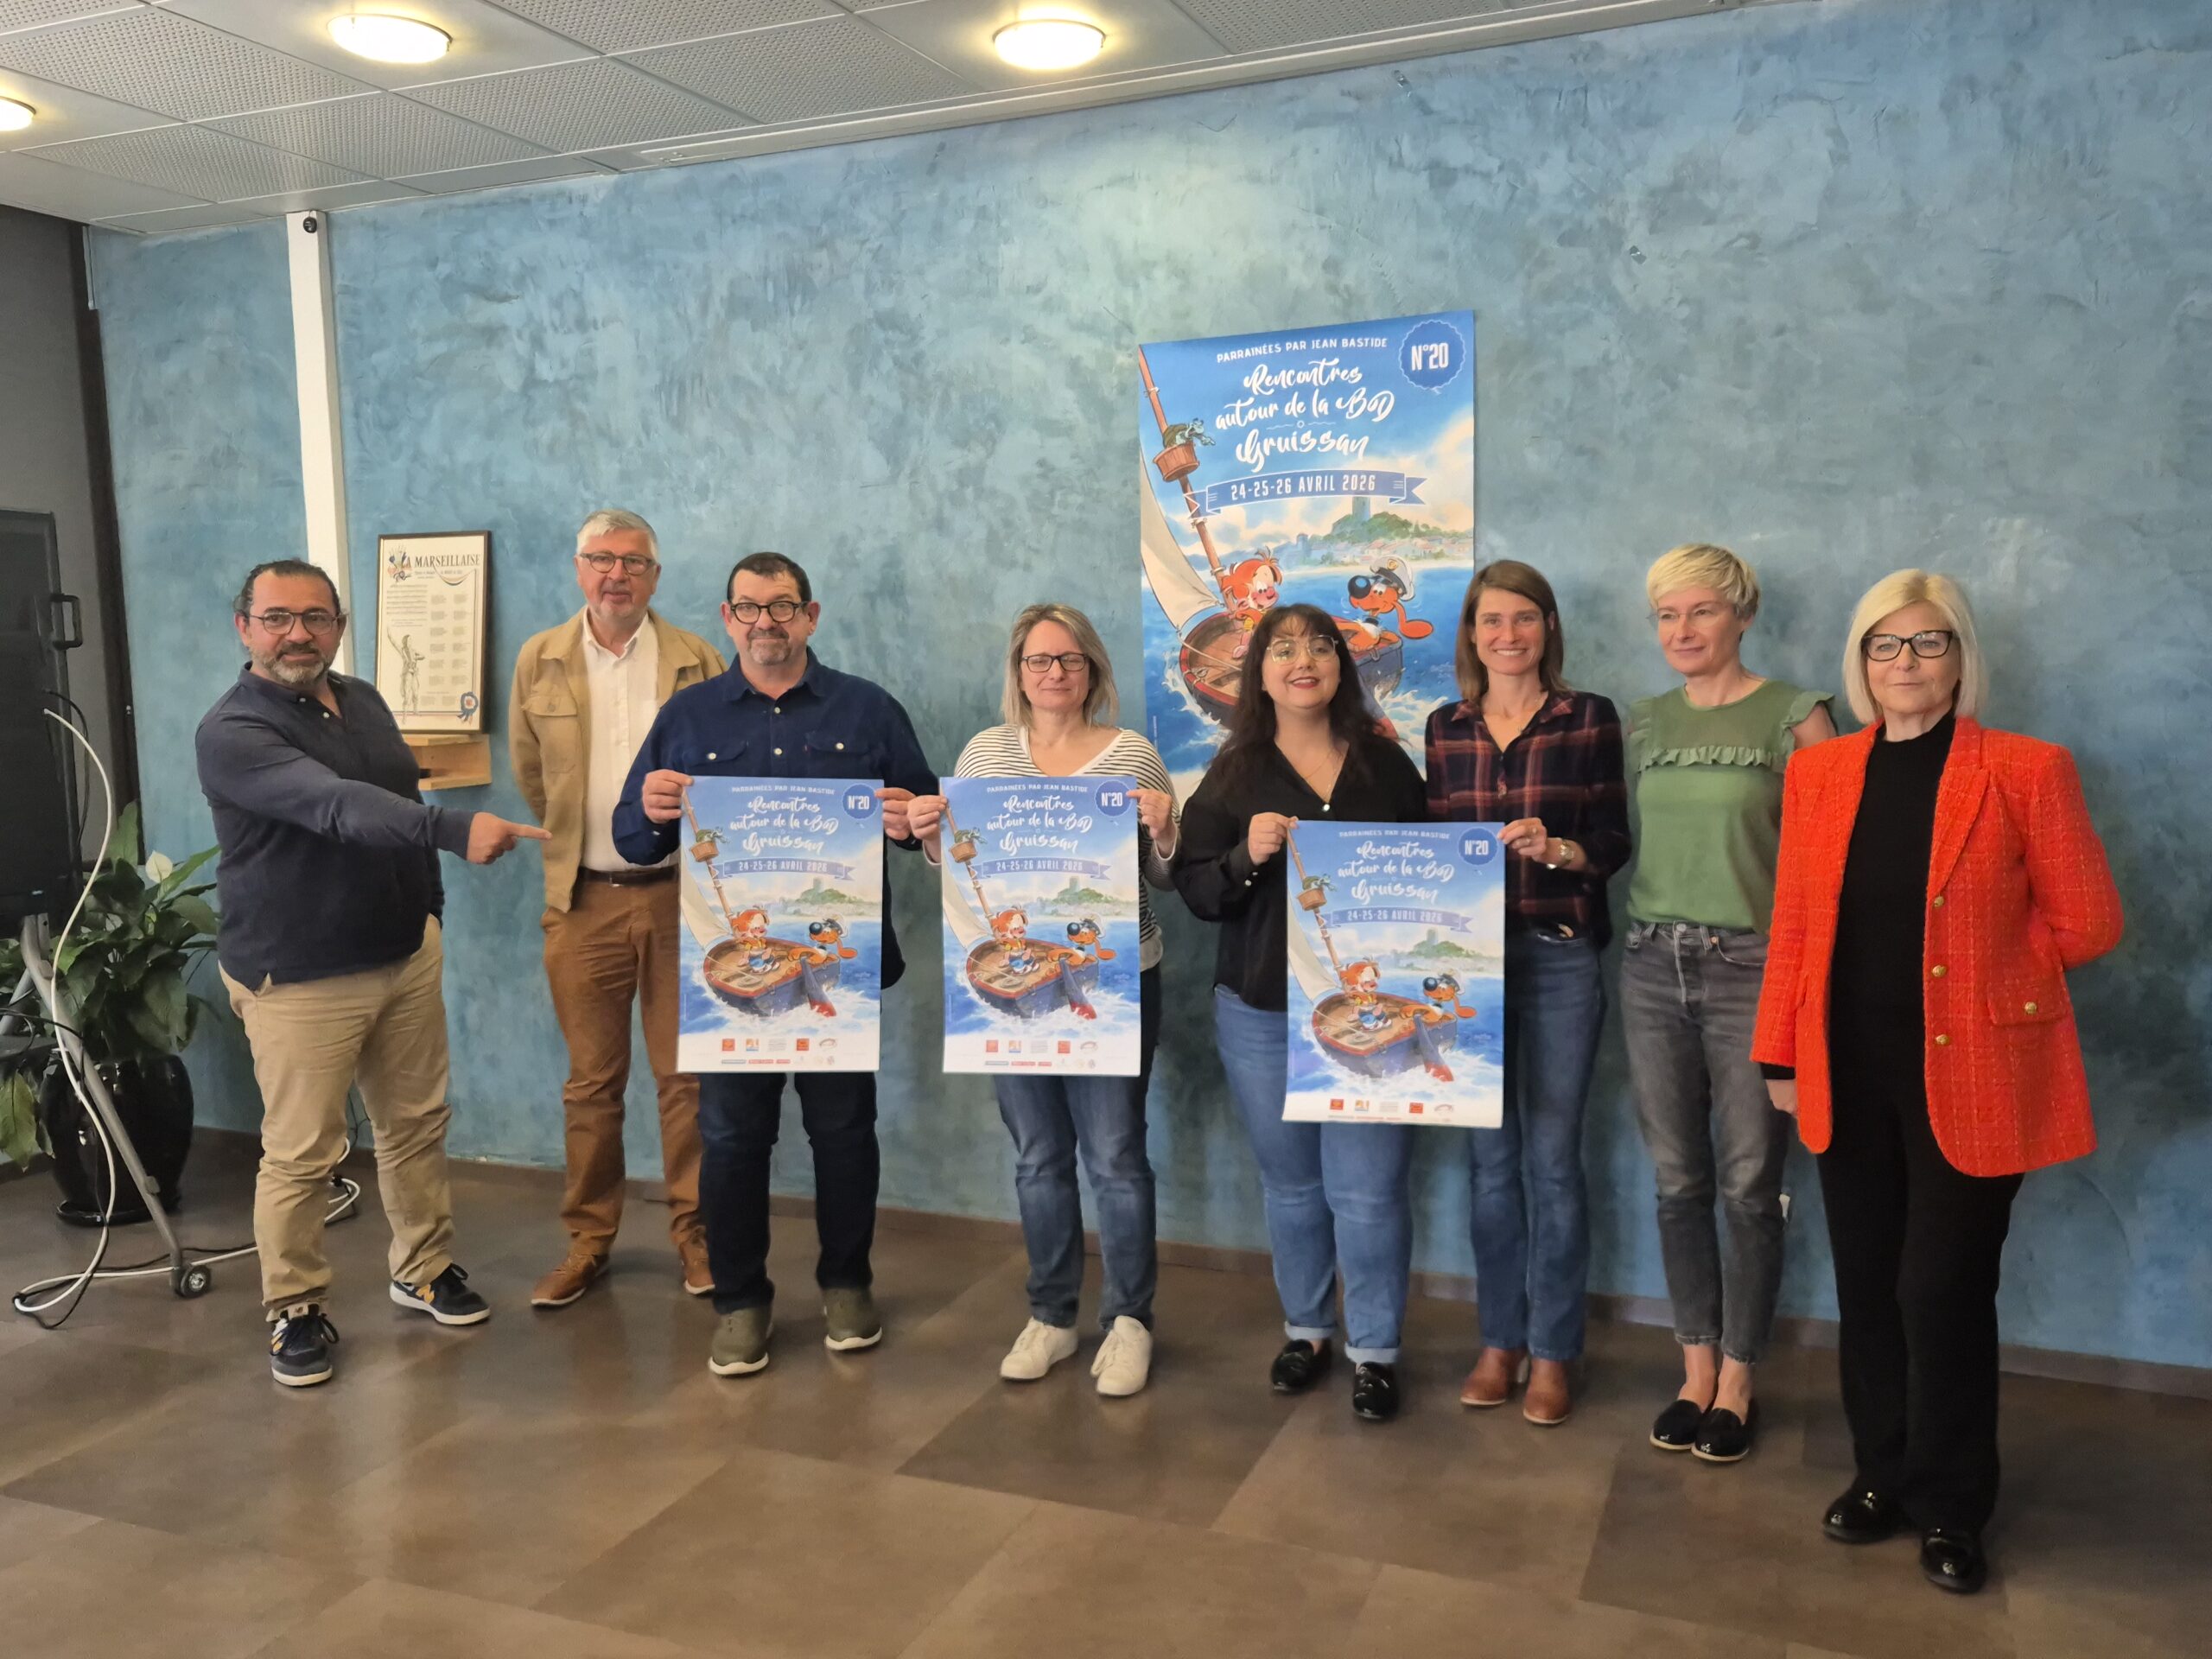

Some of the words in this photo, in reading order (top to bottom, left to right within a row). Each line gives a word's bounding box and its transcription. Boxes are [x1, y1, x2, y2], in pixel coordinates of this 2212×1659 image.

[1217, 344, 1281, 363] PARRAINÉES
[1286, 340, 1308, 352] PAR
[1311, 339, 1338, 350] JEAN
[1341, 338, 1387, 348] BASTIDE
[1243, 358, 1363, 395] Rencontres
[1216, 399, 1279, 430] autour
[1285, 391, 1307, 417] de
[1312, 389, 1329, 416] la
[1335, 387, 1395, 423] BD
[1236, 430, 1370, 473] Gruissan
[1230, 479, 1292, 501] 24-25-26
[1299, 475, 1335, 493] AVRIL
[1343, 474, 1376, 492] 2026
[415, 554, 480, 568] MARSEILLAISE
[747, 796, 820, 814] Rencontres
[1003, 795, 1074, 813] Rencontres
[730, 814, 771, 830] autour
[773, 814, 785, 828] de
[790, 813, 800, 829] la
[804, 814, 839, 835] BD
[987, 813, 1025, 830] autour
[1028, 812, 1041, 826] de
[1045, 811, 1055, 828] la
[1058, 813, 1092, 833] BD
[742, 832, 825, 856] Gruissan
[1000, 831, 1079, 856] Gruissan
[1356, 840, 1434, 860] Rencontres
[739, 861, 778, 871] 24-25-26
[780, 861, 804, 871] AVRIL
[996, 860, 1033, 872] 24-25-26
[1038, 860, 1059, 870] AVRIL
[1338, 860, 1380, 877] autour
[1383, 860, 1397, 874] de
[1402, 859, 1412, 876] la
[1416, 861, 1454, 882] BD
[1351, 879, 1439, 905] Gruissan
[1348, 910, 1388, 921] 24-25-26
[1392, 910, 1416, 920] AVRIL
